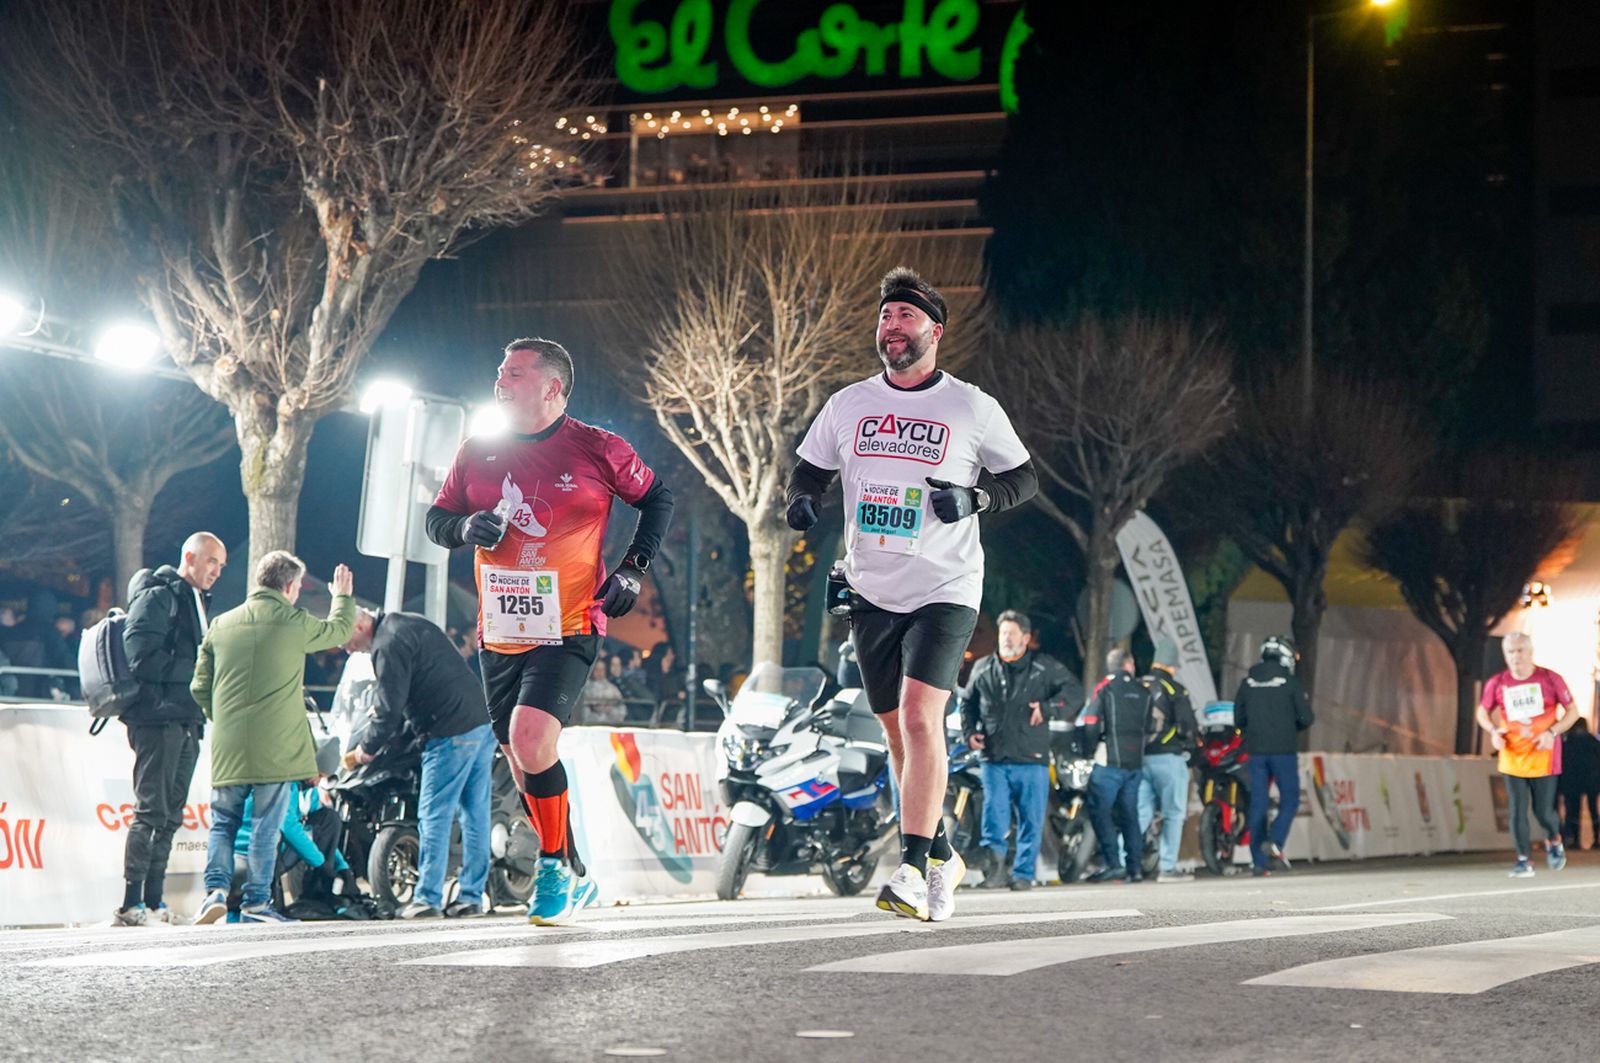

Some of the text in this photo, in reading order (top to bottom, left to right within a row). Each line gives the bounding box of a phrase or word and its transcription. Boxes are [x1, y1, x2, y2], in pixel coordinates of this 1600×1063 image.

[609, 0, 718, 93] El
[725, 0, 982, 88] Corte
[862, 414, 945, 445] CAYCU
[858, 438, 940, 460] elevadores
[889, 488, 899, 497] DE
[513, 509, 531, 527] 43
[861, 504, 916, 529] 13509
[505, 586, 530, 594] ANTÓN
[521, 578, 530, 586] DE
[497, 595, 544, 616] 1255
[660, 771, 703, 811] SAN
